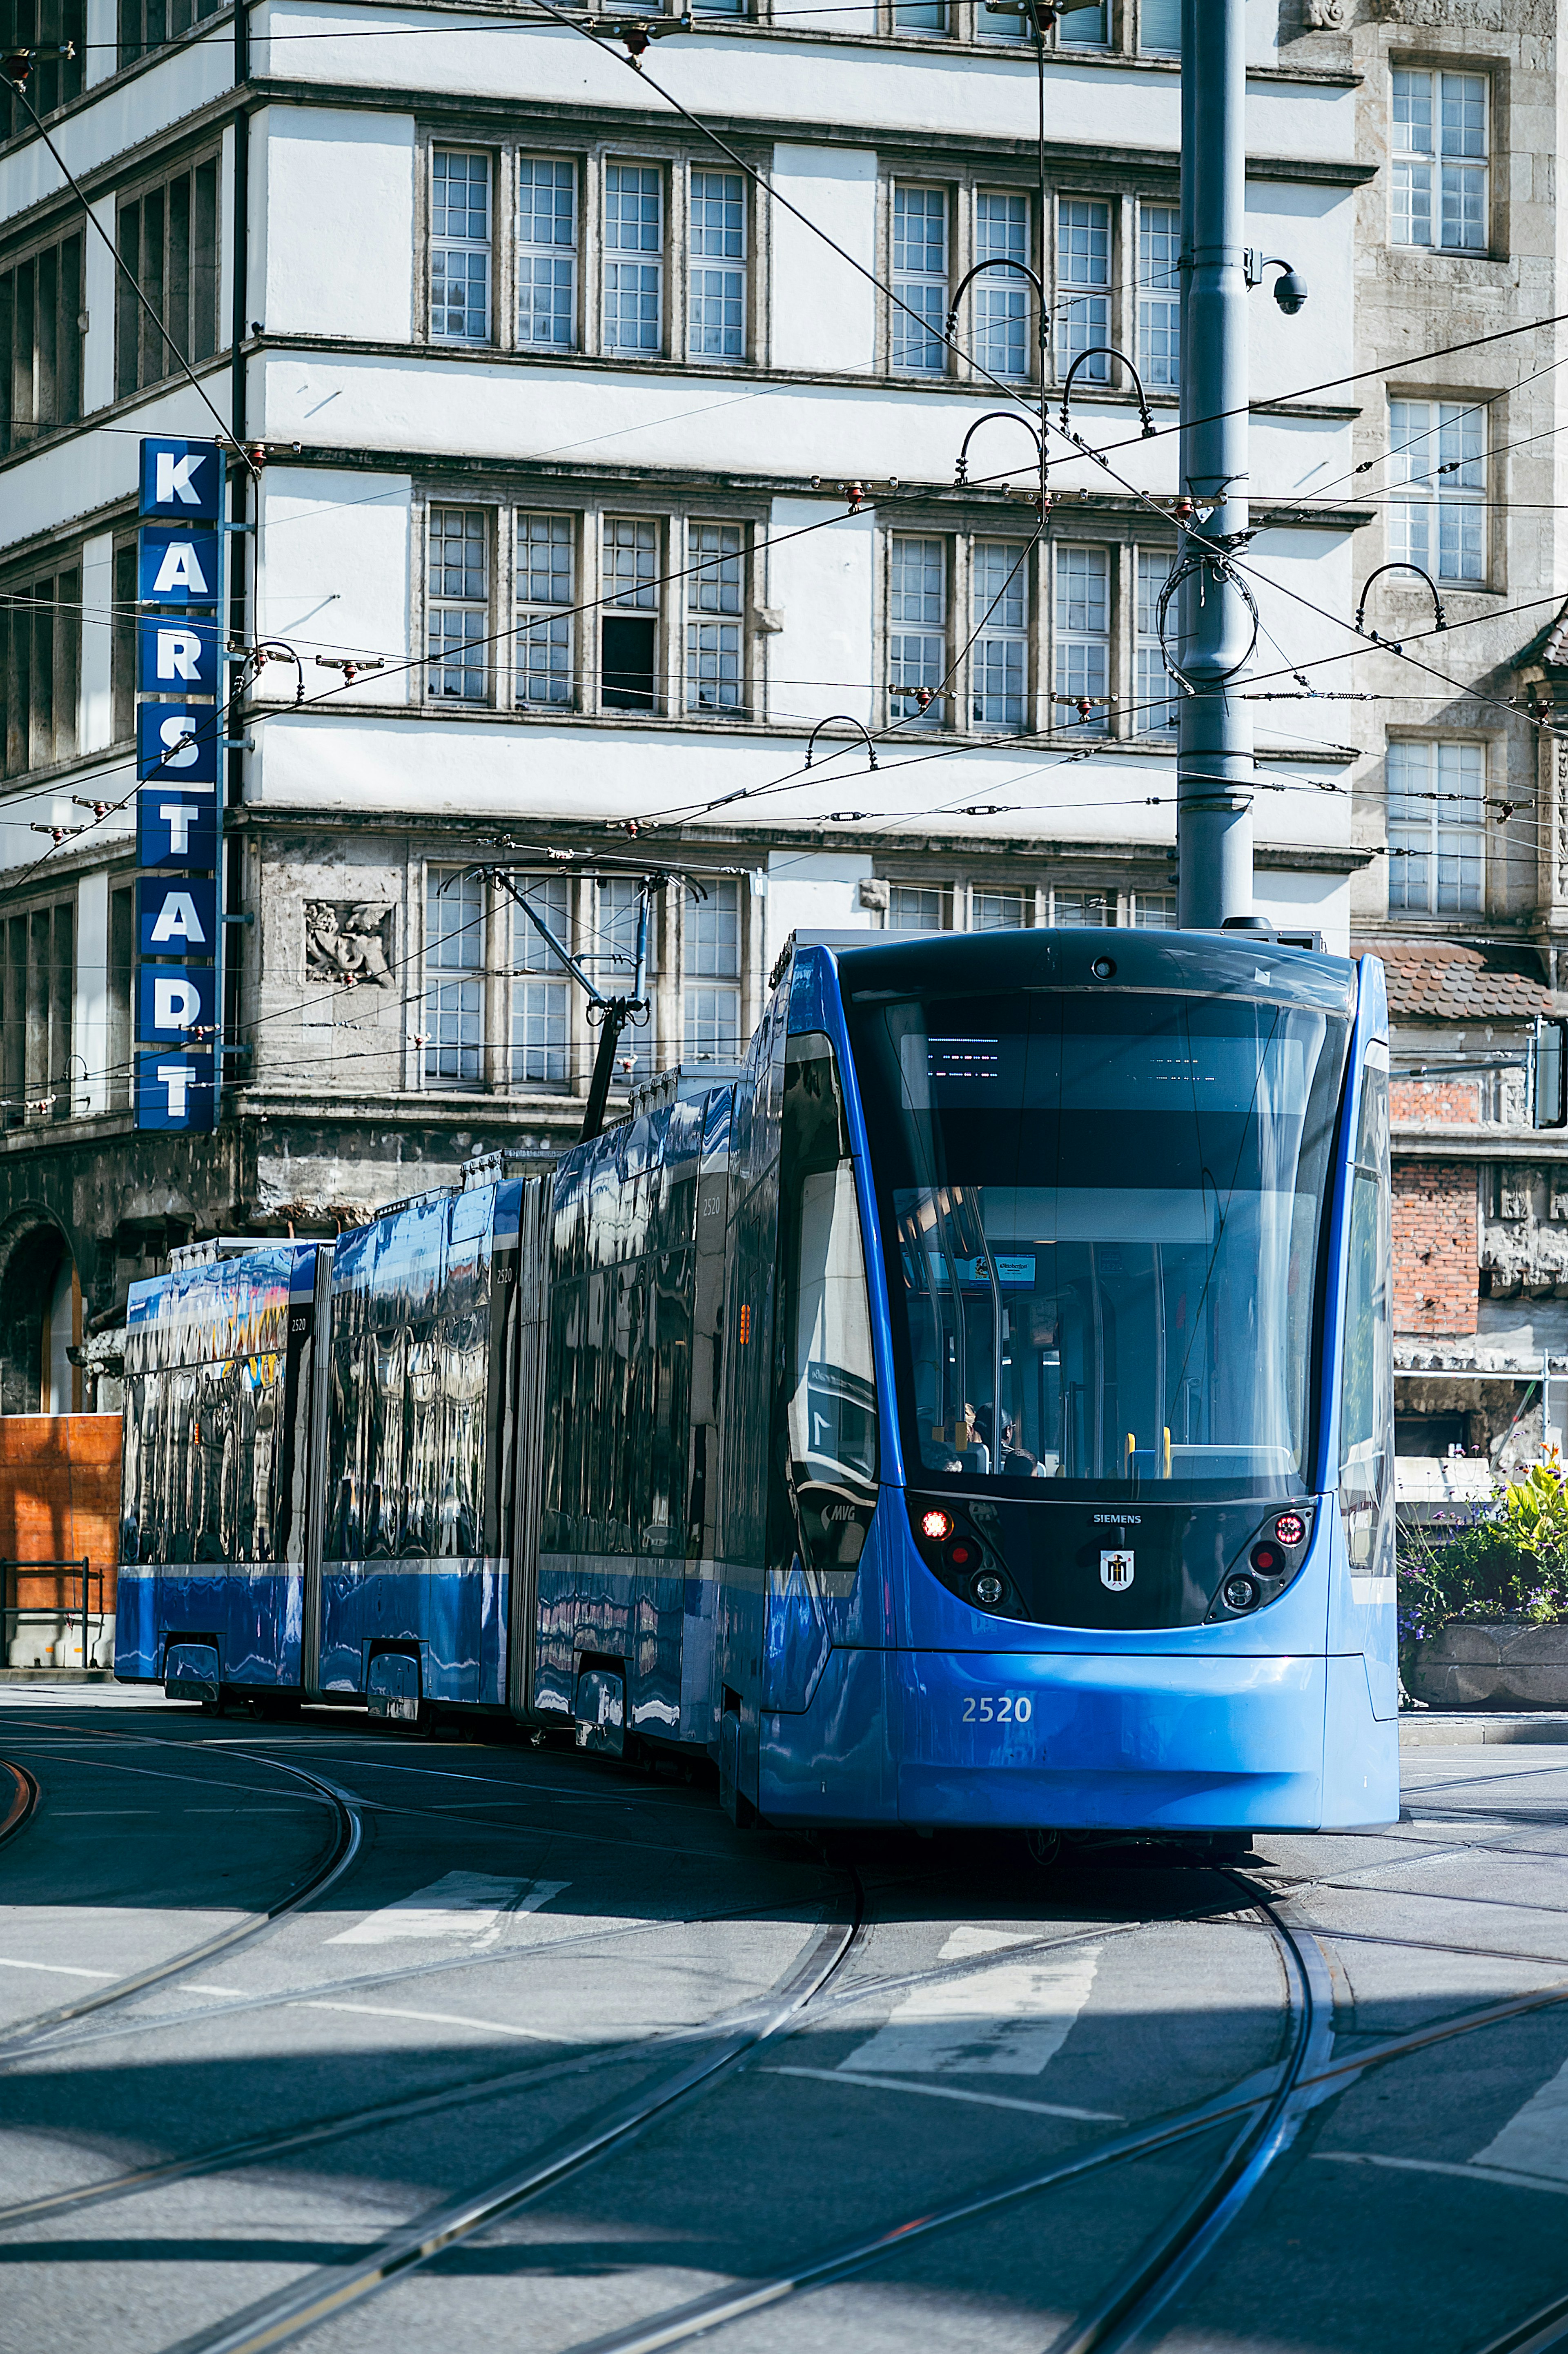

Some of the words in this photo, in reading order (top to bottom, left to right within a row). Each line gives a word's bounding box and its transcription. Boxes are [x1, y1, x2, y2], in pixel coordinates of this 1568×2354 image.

[151, 452, 208, 1117] KARSTADT
[703, 1196, 720, 1216] 2520
[497, 1267, 512, 1284] 2520
[292, 1318, 306, 1332] 2520
[830, 1505, 855, 1521] MVG
[1094, 1514, 1142, 1523] SIEMENS
[962, 1697, 1032, 1723] 2520
